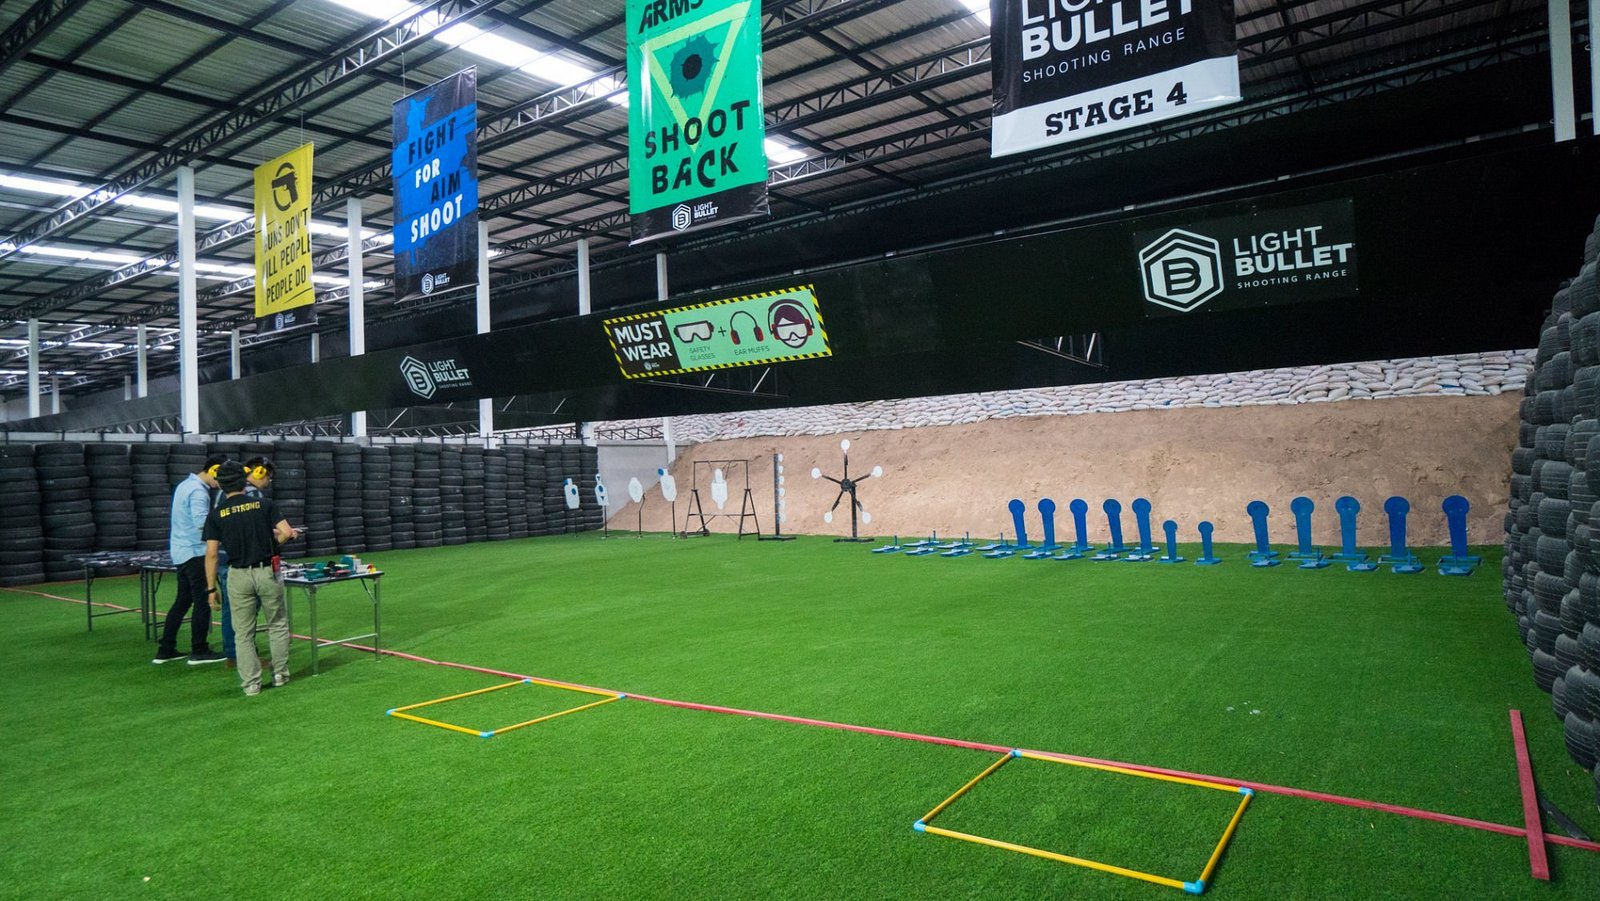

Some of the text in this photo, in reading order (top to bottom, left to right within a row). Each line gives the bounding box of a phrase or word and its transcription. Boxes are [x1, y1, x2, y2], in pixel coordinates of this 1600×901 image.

[1023, 27, 1186, 83] SHOOTING RANGE
[1045, 81, 1187, 137] STAGE 4
[408, 116, 457, 165] FIGHT
[645, 100, 750, 159] SHOOT
[415, 158, 441, 188] FOR
[652, 142, 739, 195] BACK
[431, 170, 461, 204] AIM
[411, 194, 463, 243] SHOOT
[1233, 225, 1323, 257] LIGHT
[1234, 242, 1353, 277] BULLET
[266, 265, 307, 306] PEOPLE DO
[1237, 269, 1348, 289] SHOOTING RANGE
[614, 320, 664, 344] MUST
[622, 342, 672, 361] WEAR
[689, 346, 711, 354] SAFETY
[690, 353, 716, 361] GLASSES
[750, 345, 771, 354] MUFFS
[428, 359, 457, 372] LIGHT
[433, 368, 470, 382] BULLET
[220, 501, 260, 518] BE STRONG
